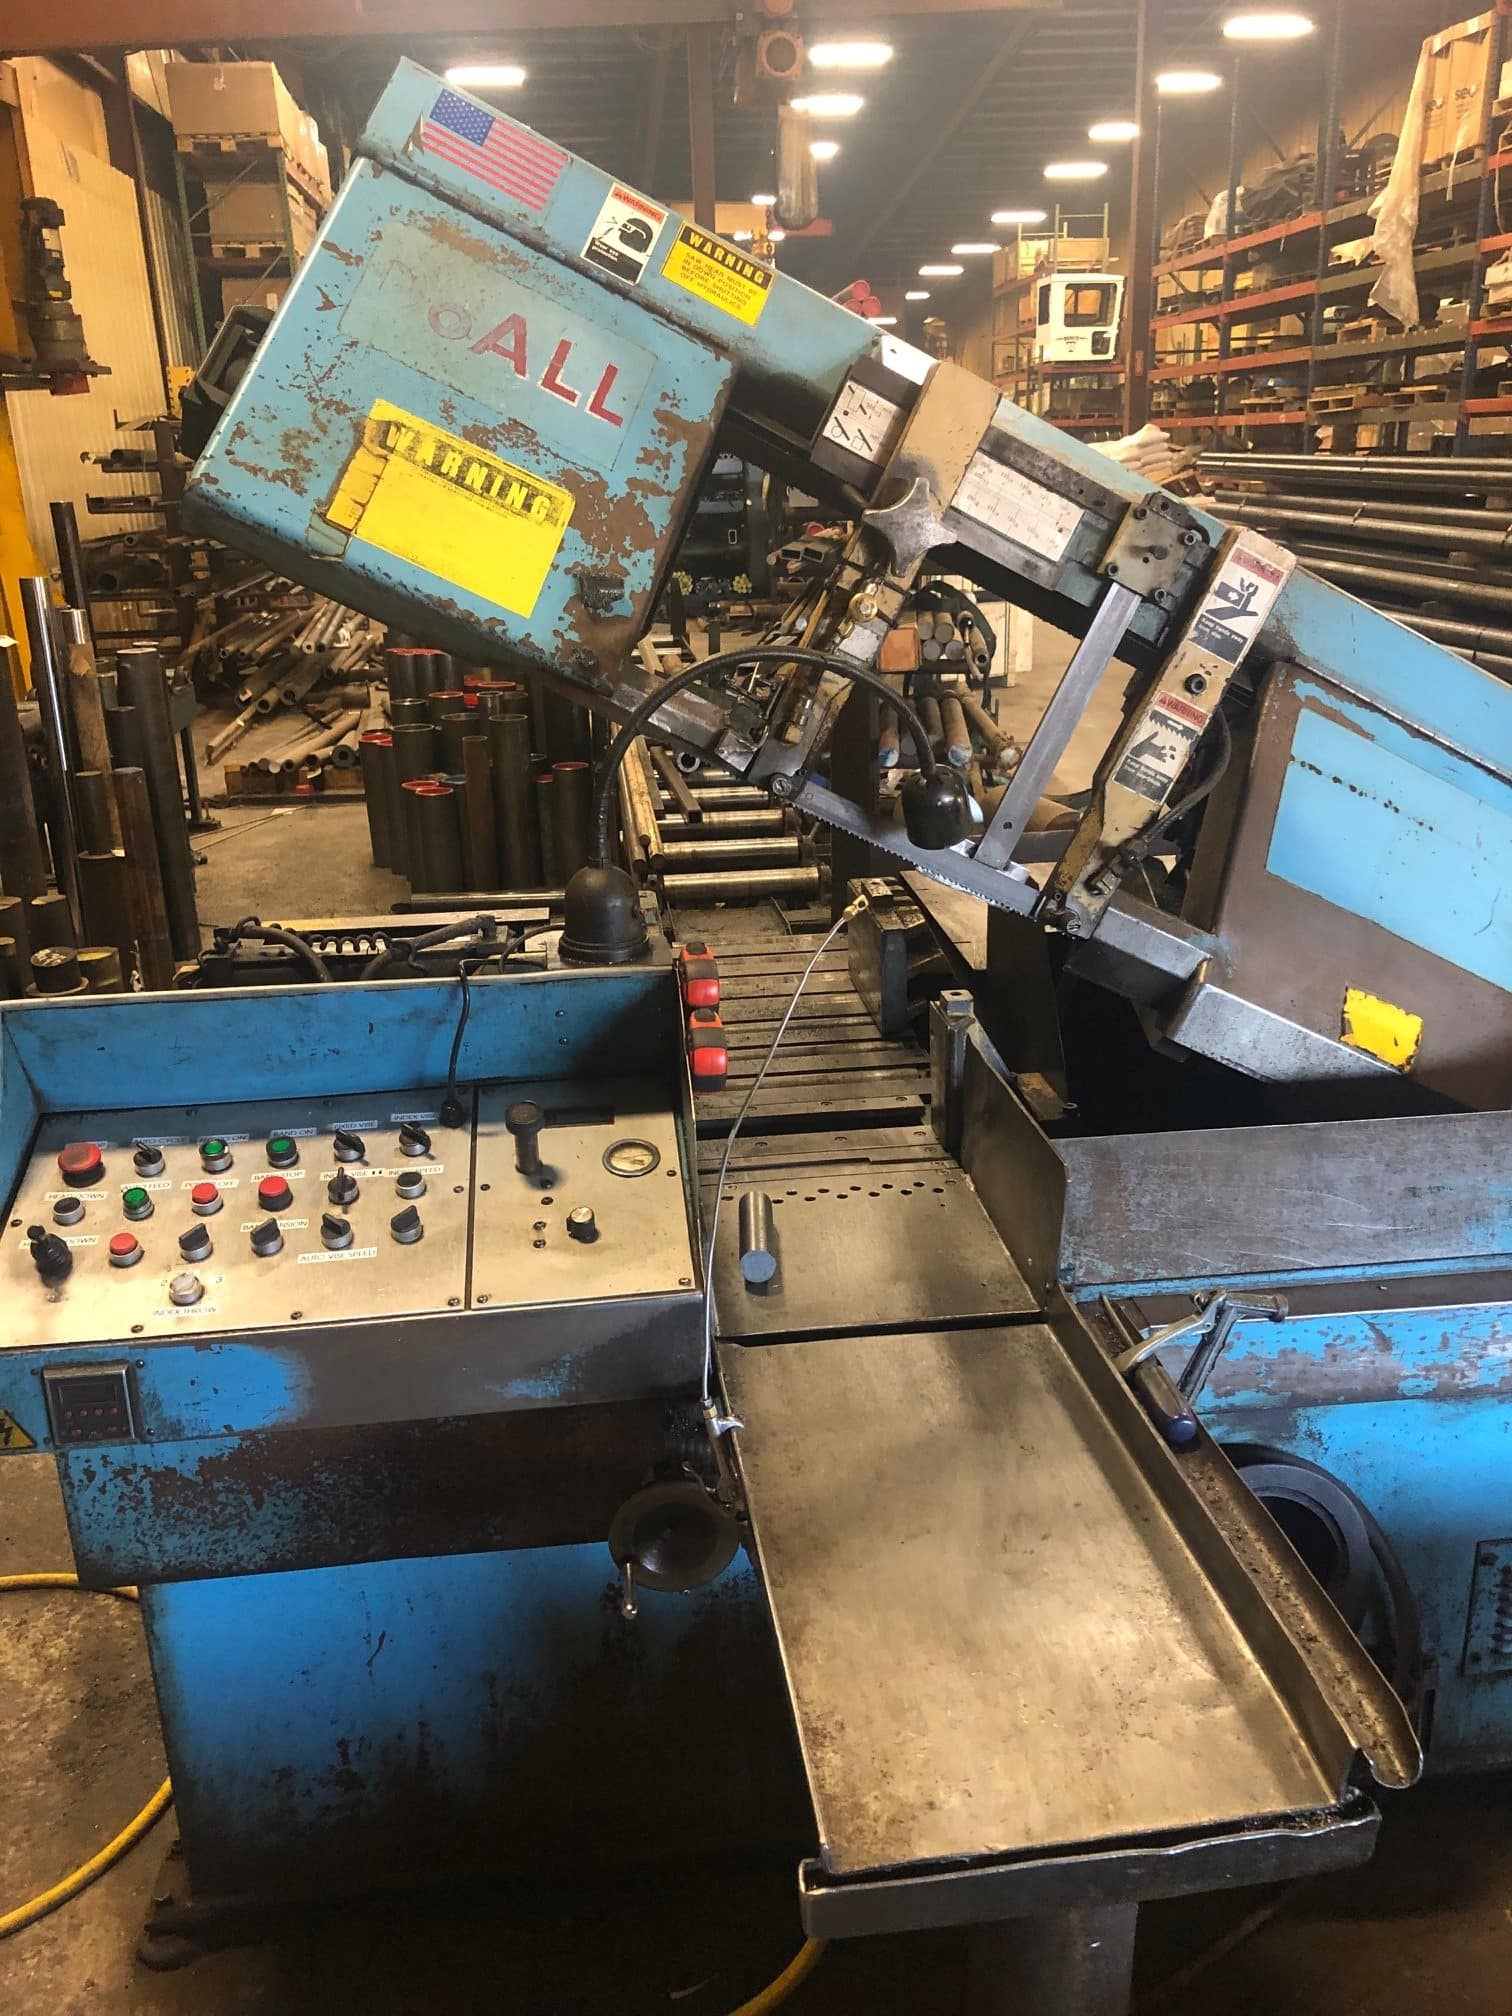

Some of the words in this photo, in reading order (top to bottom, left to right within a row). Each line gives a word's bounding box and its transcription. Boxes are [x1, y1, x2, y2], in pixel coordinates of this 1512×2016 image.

[689, 231, 765, 285] WARNING
[704, 263, 725, 278] HEAD
[680, 272, 694, 282] OFF
[681, 265, 709, 283] BEFORE
[712, 282, 747, 306] SHUTTING
[693, 264, 716, 281] DOWN
[718, 276, 751, 301] POSITION
[386, 424, 552, 524] WARNING
[1167, 698, 1204, 724] WARNING
[348, 1249, 376, 1258] SPEED
